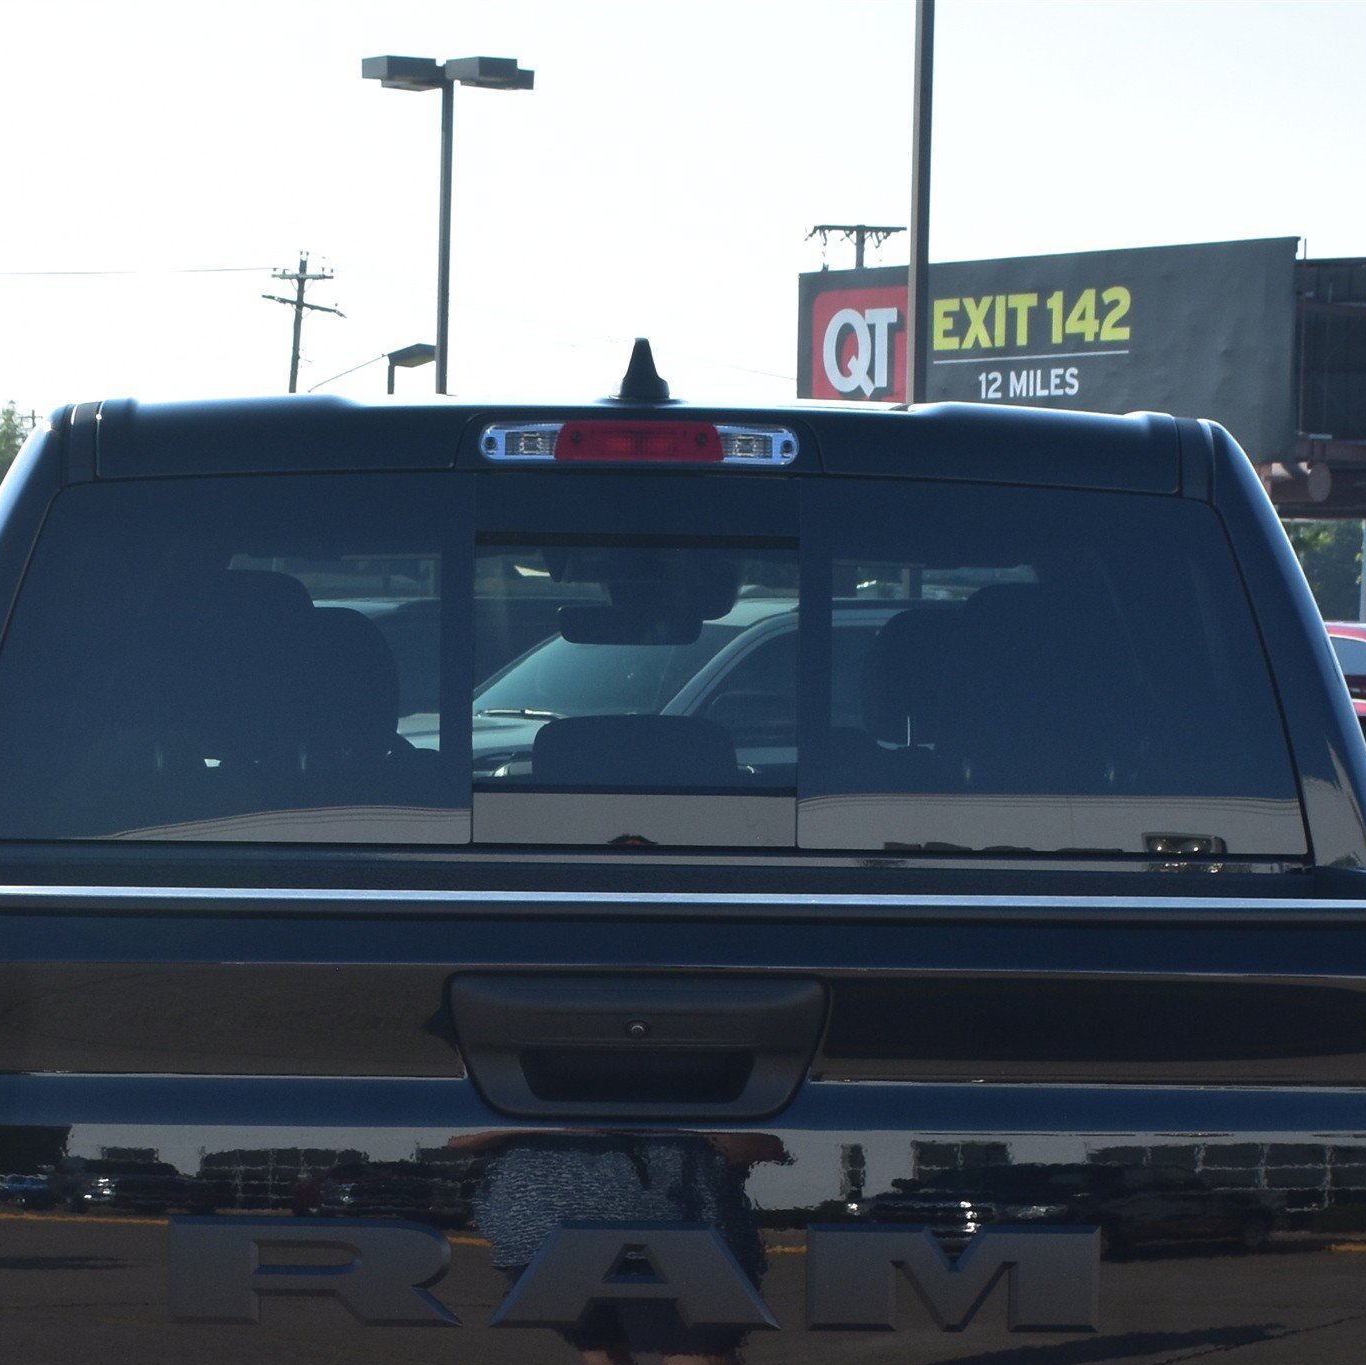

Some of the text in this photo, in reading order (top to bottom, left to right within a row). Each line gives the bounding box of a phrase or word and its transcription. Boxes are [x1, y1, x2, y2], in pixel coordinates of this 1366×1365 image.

[822, 307, 898, 398] QT
[933, 286, 1131, 351] EXIT 142
[978, 367, 1080, 399] 12 MILES
[168, 1215, 1103, 1333] RAM
